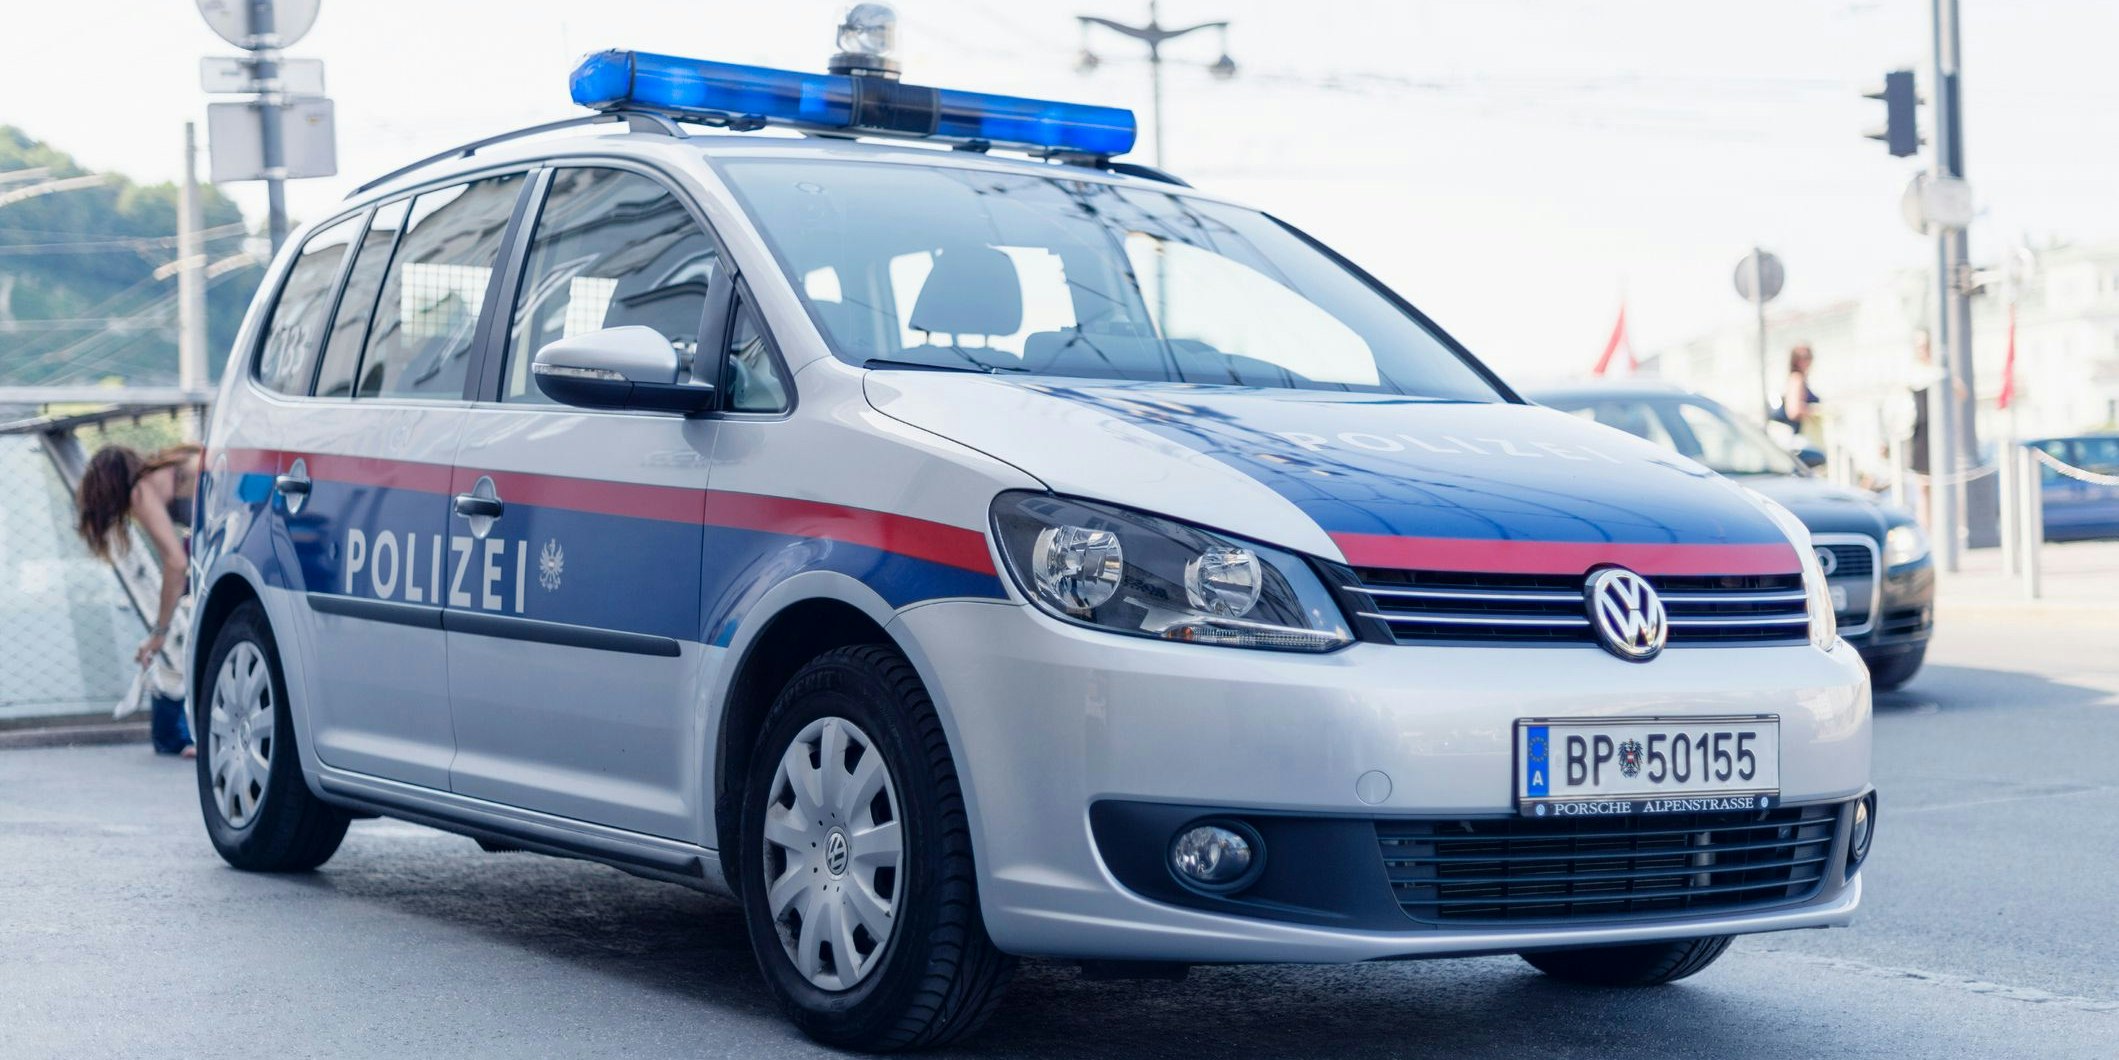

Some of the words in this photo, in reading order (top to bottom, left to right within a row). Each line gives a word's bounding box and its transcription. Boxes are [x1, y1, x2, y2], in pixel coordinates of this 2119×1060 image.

[1273, 430, 1623, 465] POLIZEI
[345, 528, 528, 614] POLIZEI
[1566, 734, 1614, 786] BP
[1647, 731, 1756, 784] 50155
[1532, 770, 1544, 786] A
[1554, 801, 1632, 816] PORSCHE
[1643, 797, 1755, 813] ALPENSTRASSE
